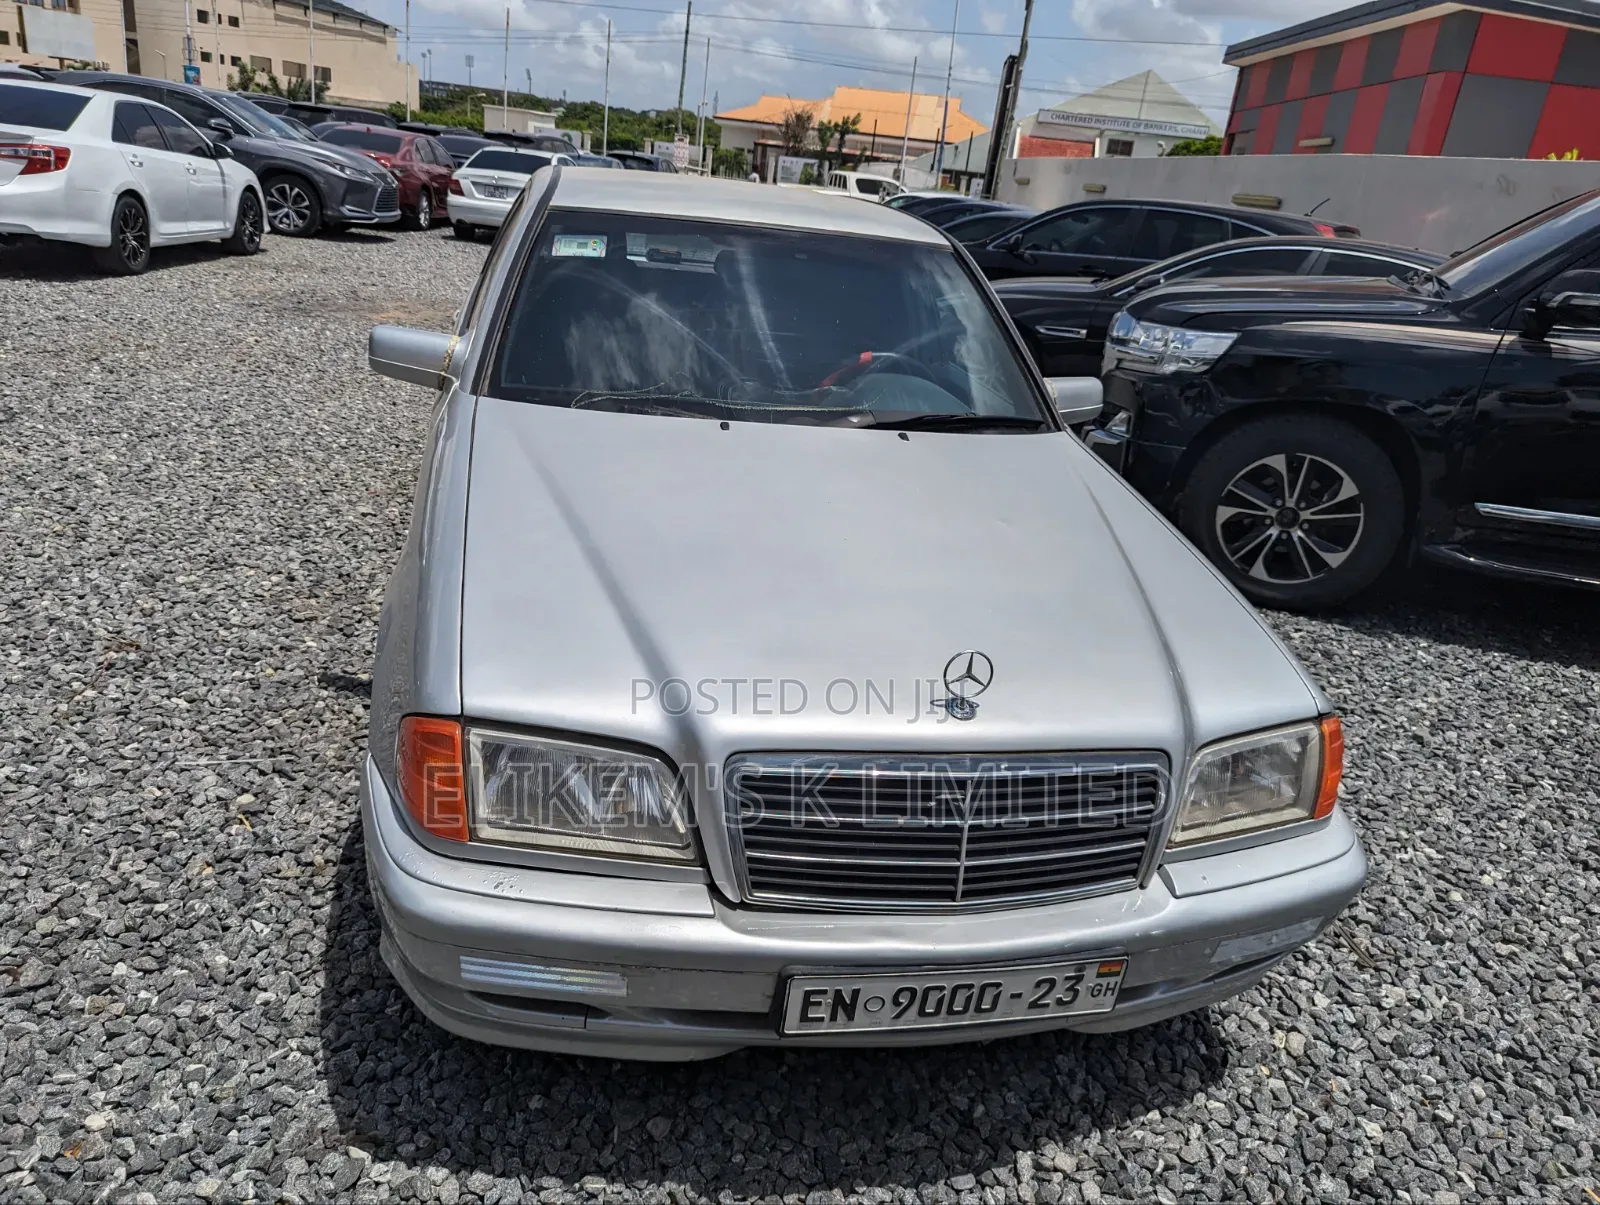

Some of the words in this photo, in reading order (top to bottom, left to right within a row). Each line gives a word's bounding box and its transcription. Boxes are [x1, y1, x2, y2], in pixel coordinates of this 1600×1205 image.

[1050, 112, 1093, 125] CHARTERED
[1093, 117, 1131, 129] INSTITUTE
[1132, 121, 1141, 129] OF
[1091, 981, 1118, 998] GH
[800, 988, 861, 1023] EN
